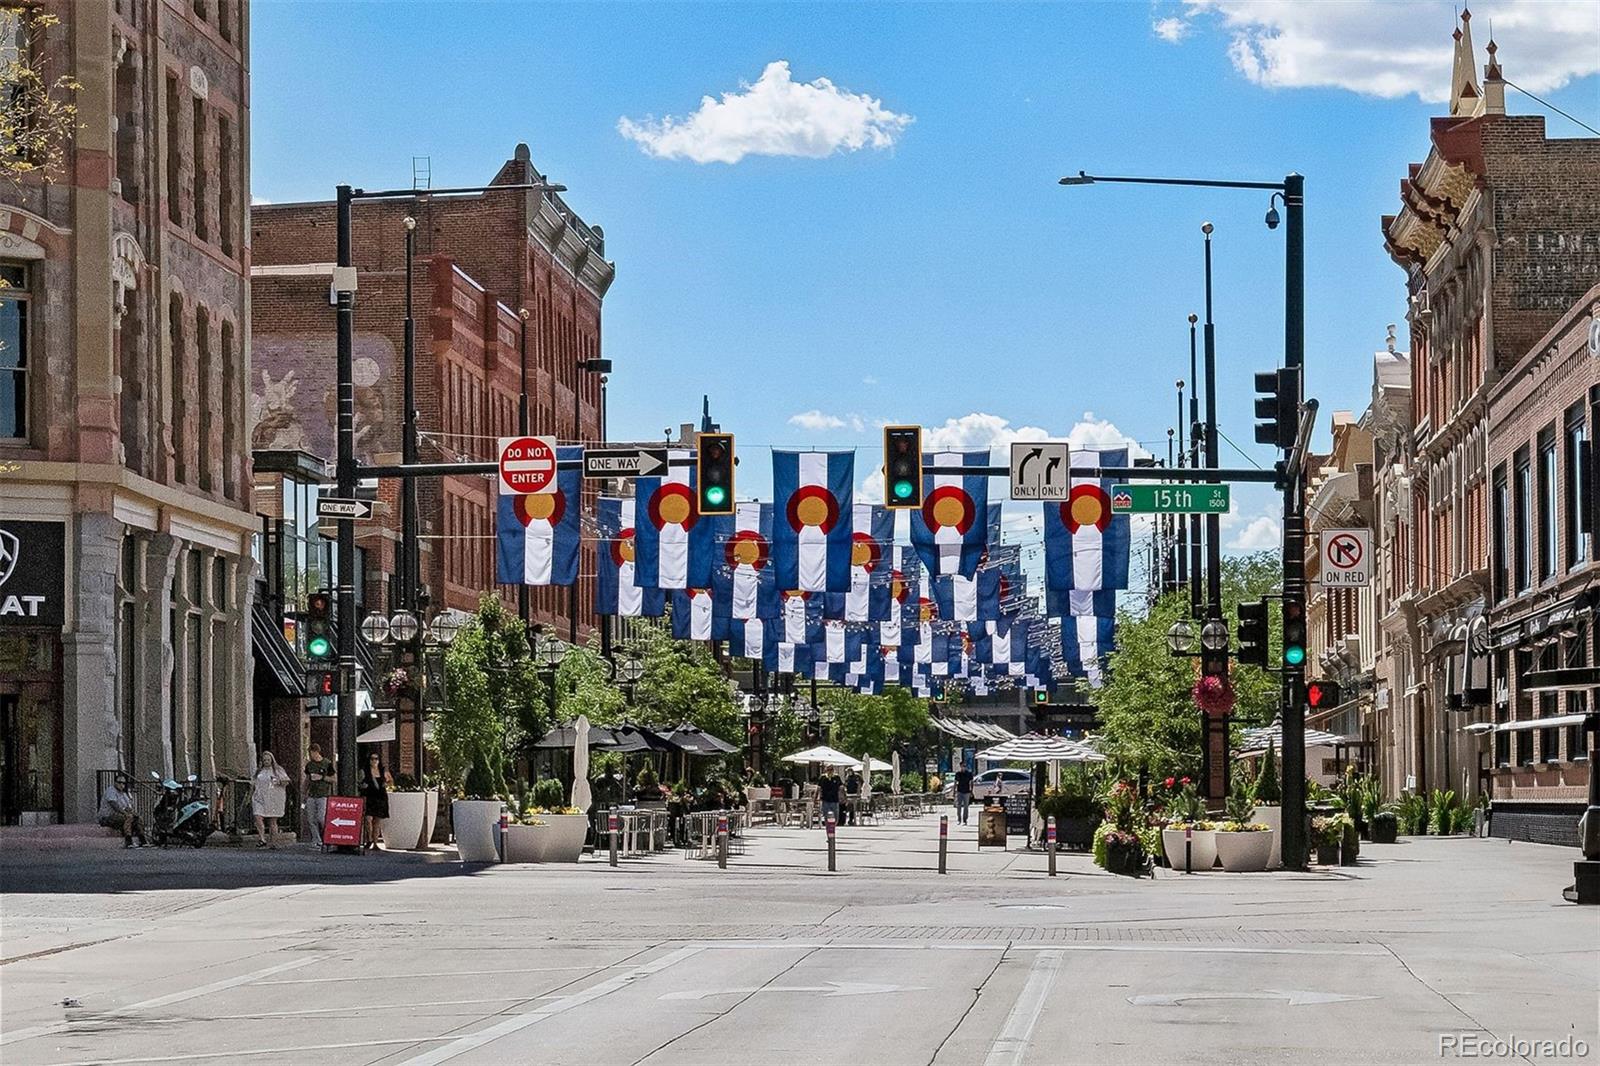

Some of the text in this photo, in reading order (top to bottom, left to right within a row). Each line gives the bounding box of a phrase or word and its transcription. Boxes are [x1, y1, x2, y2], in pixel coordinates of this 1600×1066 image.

[508, 447, 548, 458] DO NOT
[590, 458, 640, 469] ONE WAY
[512, 473, 545, 483] ENTER
[1014, 486, 1036, 496] ONLY
[1042, 486, 1065, 496] ONLY
[1213, 489, 1222, 498] St
[1154, 489, 1192, 508] 15th
[1209, 499, 1226, 508] 1500
[322, 503, 356, 513] ONE WAY
[1326, 571, 1364, 583] ON RED
